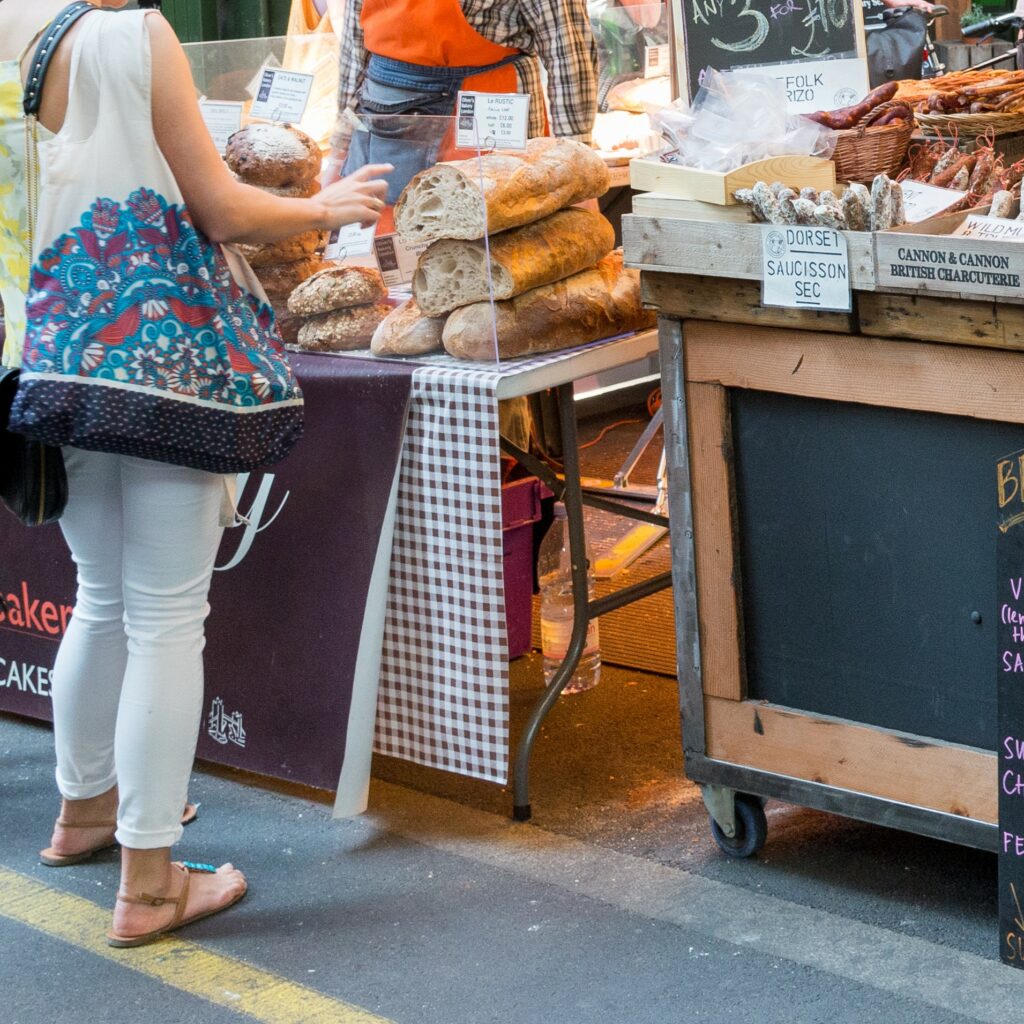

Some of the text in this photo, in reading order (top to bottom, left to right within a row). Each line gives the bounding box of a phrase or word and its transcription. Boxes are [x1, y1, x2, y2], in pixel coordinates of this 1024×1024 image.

[776, 73, 824, 89] FOLK
[968, 220, 1003, 234] WILD
[786, 229, 839, 247] DORSET
[897, 247, 1009, 269] CANNON & CANNON
[767, 260, 846, 279] SAUCISSON
[890, 264, 1020, 287] BRITISH CHARCUTERIE
[795, 280, 820, 298] SEC
[0, 581, 74, 636] aker
